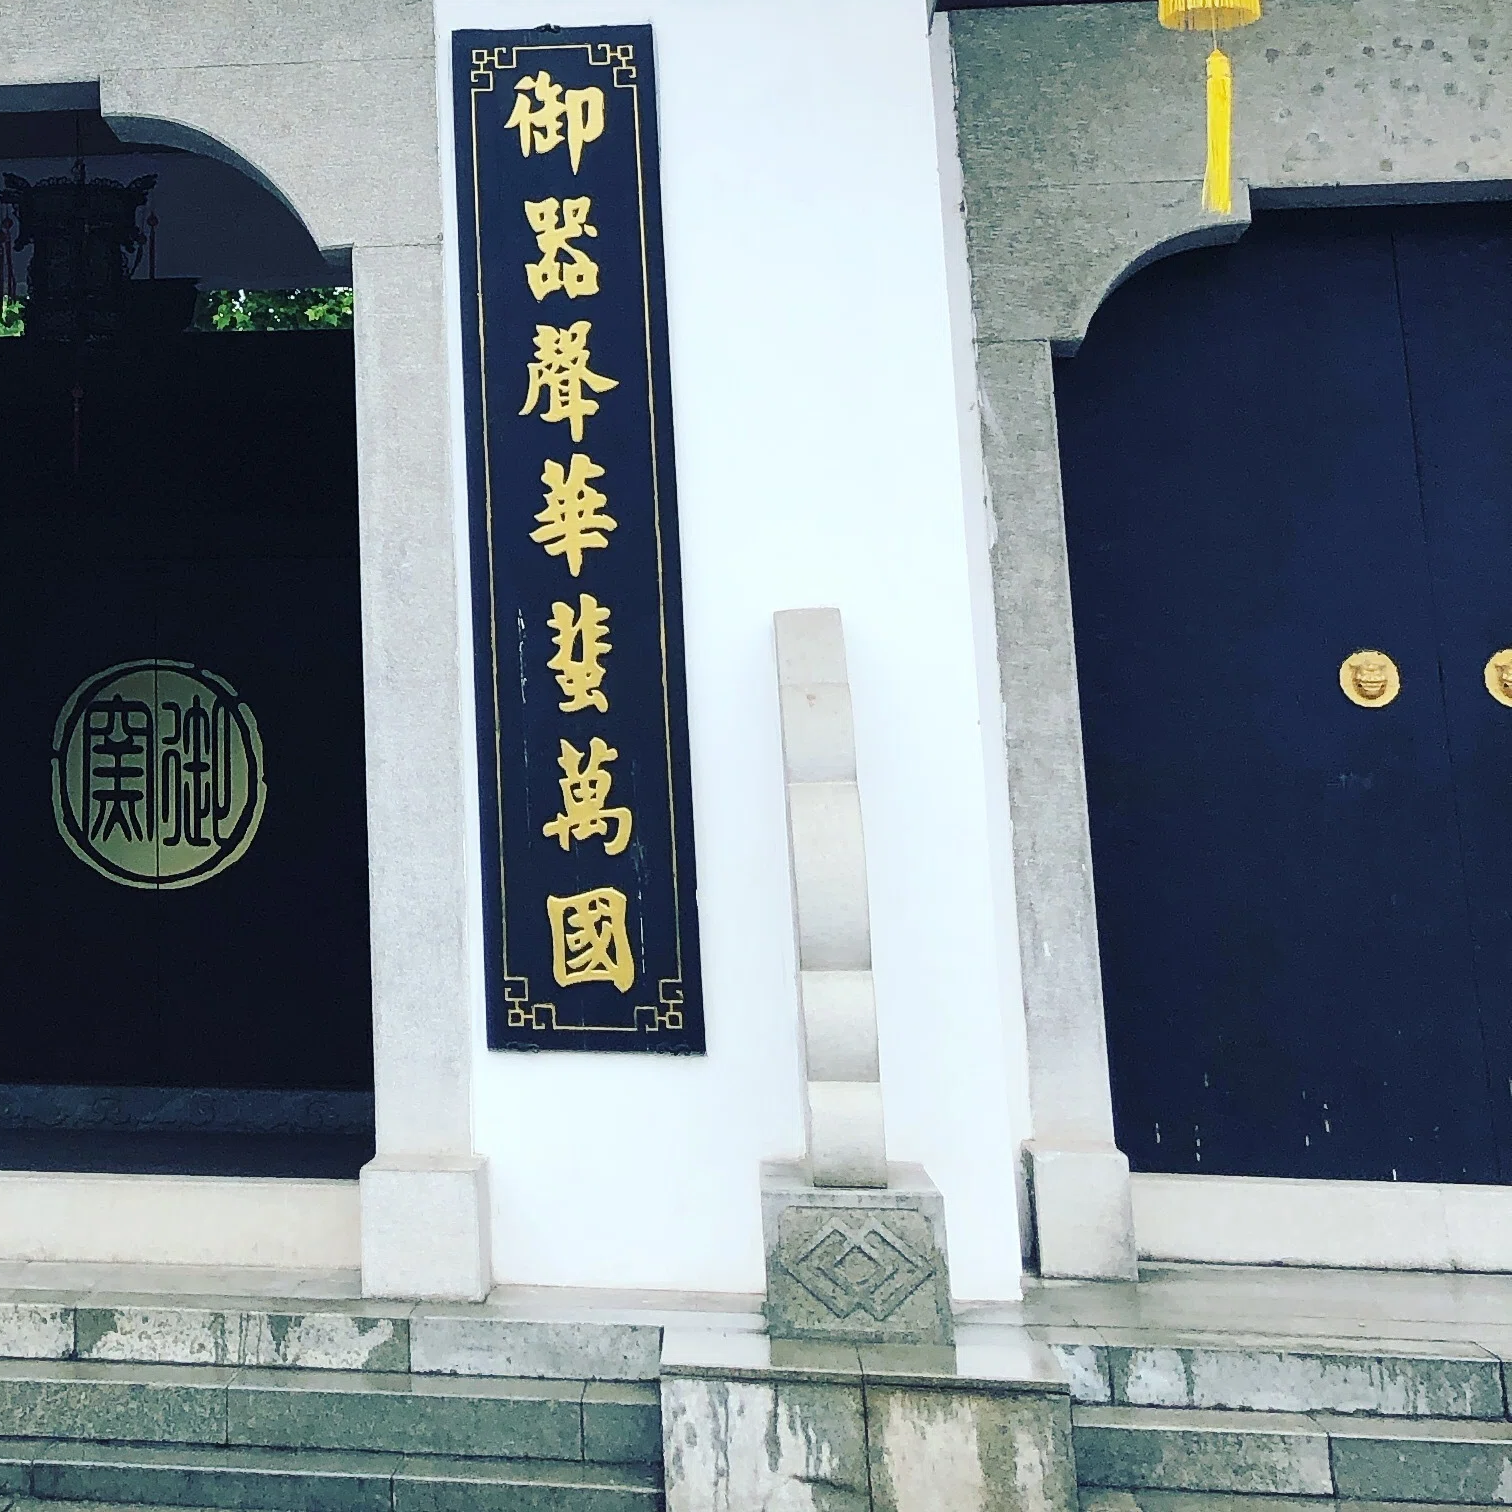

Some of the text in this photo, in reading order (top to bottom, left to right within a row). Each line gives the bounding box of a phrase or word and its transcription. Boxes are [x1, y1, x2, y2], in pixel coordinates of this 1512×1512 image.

[504, 70, 636, 995] 御器聲華蜚萬國
